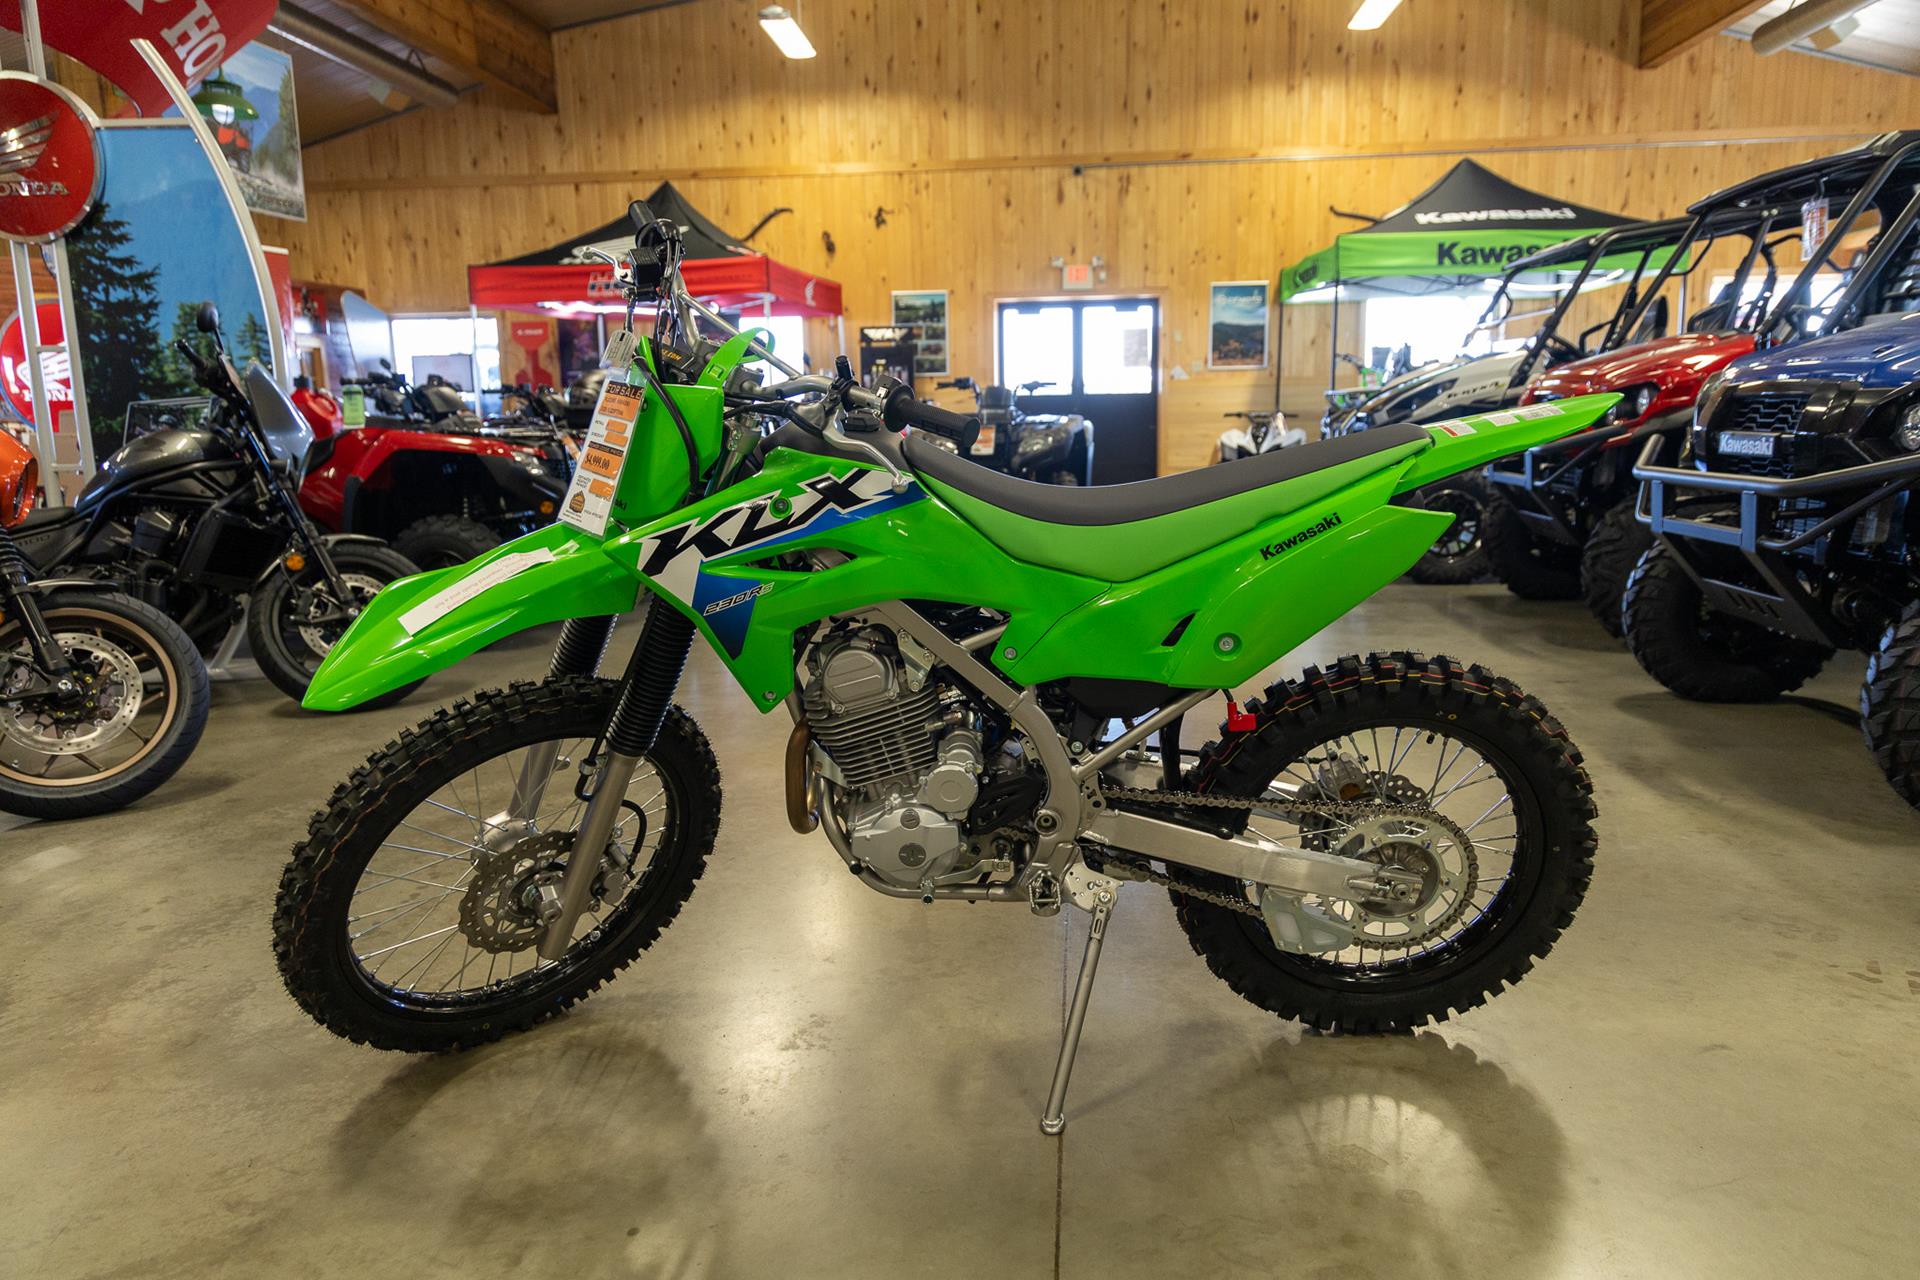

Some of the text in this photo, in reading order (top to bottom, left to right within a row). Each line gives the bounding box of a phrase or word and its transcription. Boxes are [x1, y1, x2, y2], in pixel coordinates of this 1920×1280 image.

[160, 0, 227, 86] HO
[0, 181, 70, 197] ONDA
[1414, 207, 1577, 225] Kawasaki
[1437, 240, 1544, 266] Kawas
[606, 384, 644, 400] FOR SALE
[1719, 433, 1775, 456] Kawasaki
[641, 469, 873, 577] KLX
[1258, 512, 1343, 560] Kawasaki
